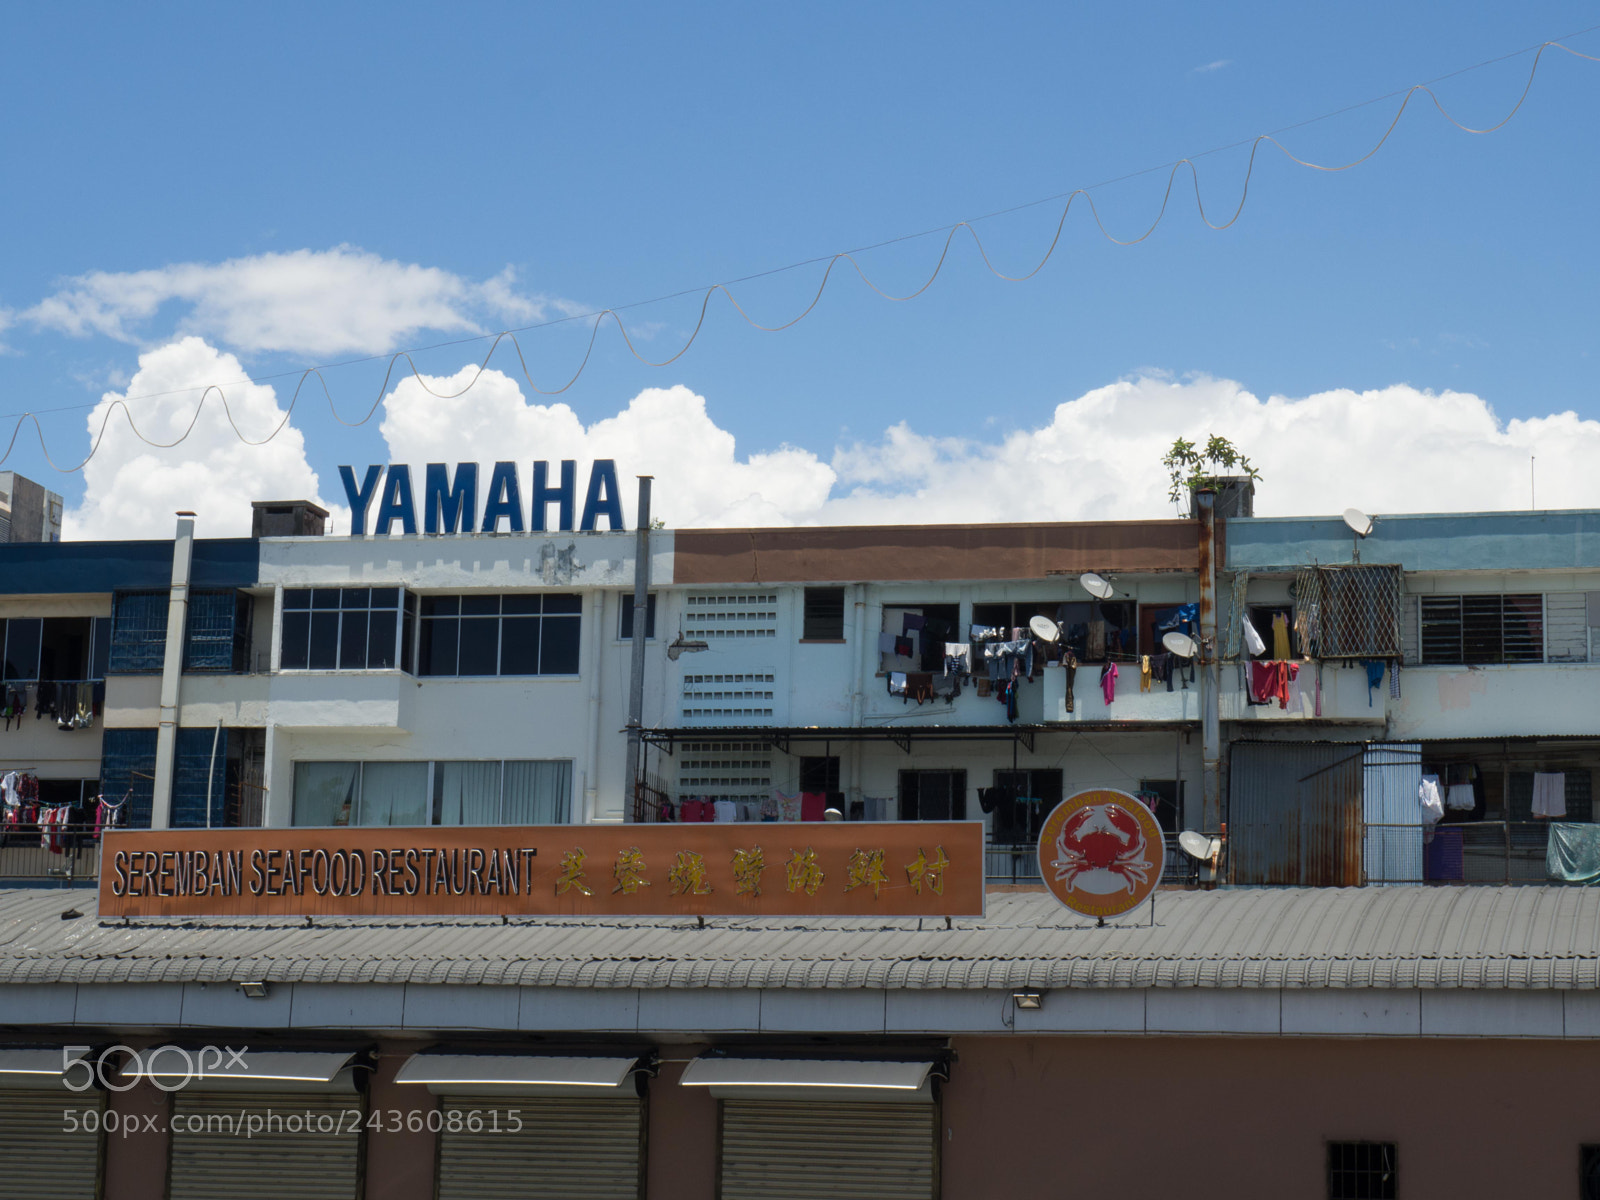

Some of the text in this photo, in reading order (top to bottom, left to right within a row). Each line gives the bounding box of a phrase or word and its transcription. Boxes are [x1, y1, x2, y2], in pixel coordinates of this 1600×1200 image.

[338, 459, 626, 535] YAMAHA
[1041, 791, 1159, 845] Seremban Seafood
[112, 847, 537, 897] SEREMBAN SEAFOOD RESTAURANT
[1065, 895, 1139, 916] Restaurant
